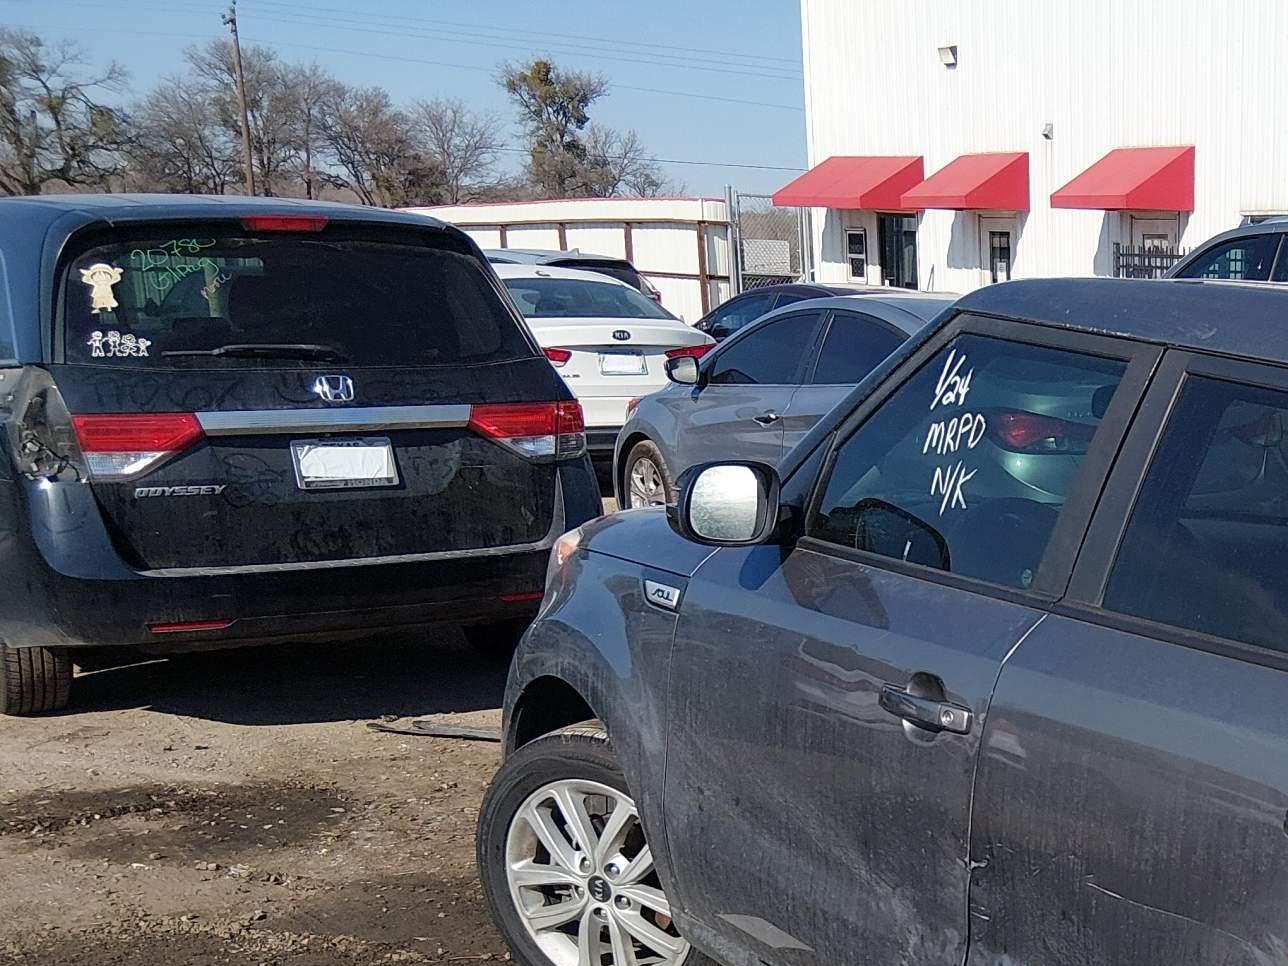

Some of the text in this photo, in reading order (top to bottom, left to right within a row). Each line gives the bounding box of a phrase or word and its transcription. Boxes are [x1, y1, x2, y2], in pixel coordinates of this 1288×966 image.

[930, 349, 974, 410] 1/24
[922, 412, 986, 456] MRPD
[134, 484, 226, 499] ODYSSEY
[930, 459, 978, 517] N/K
